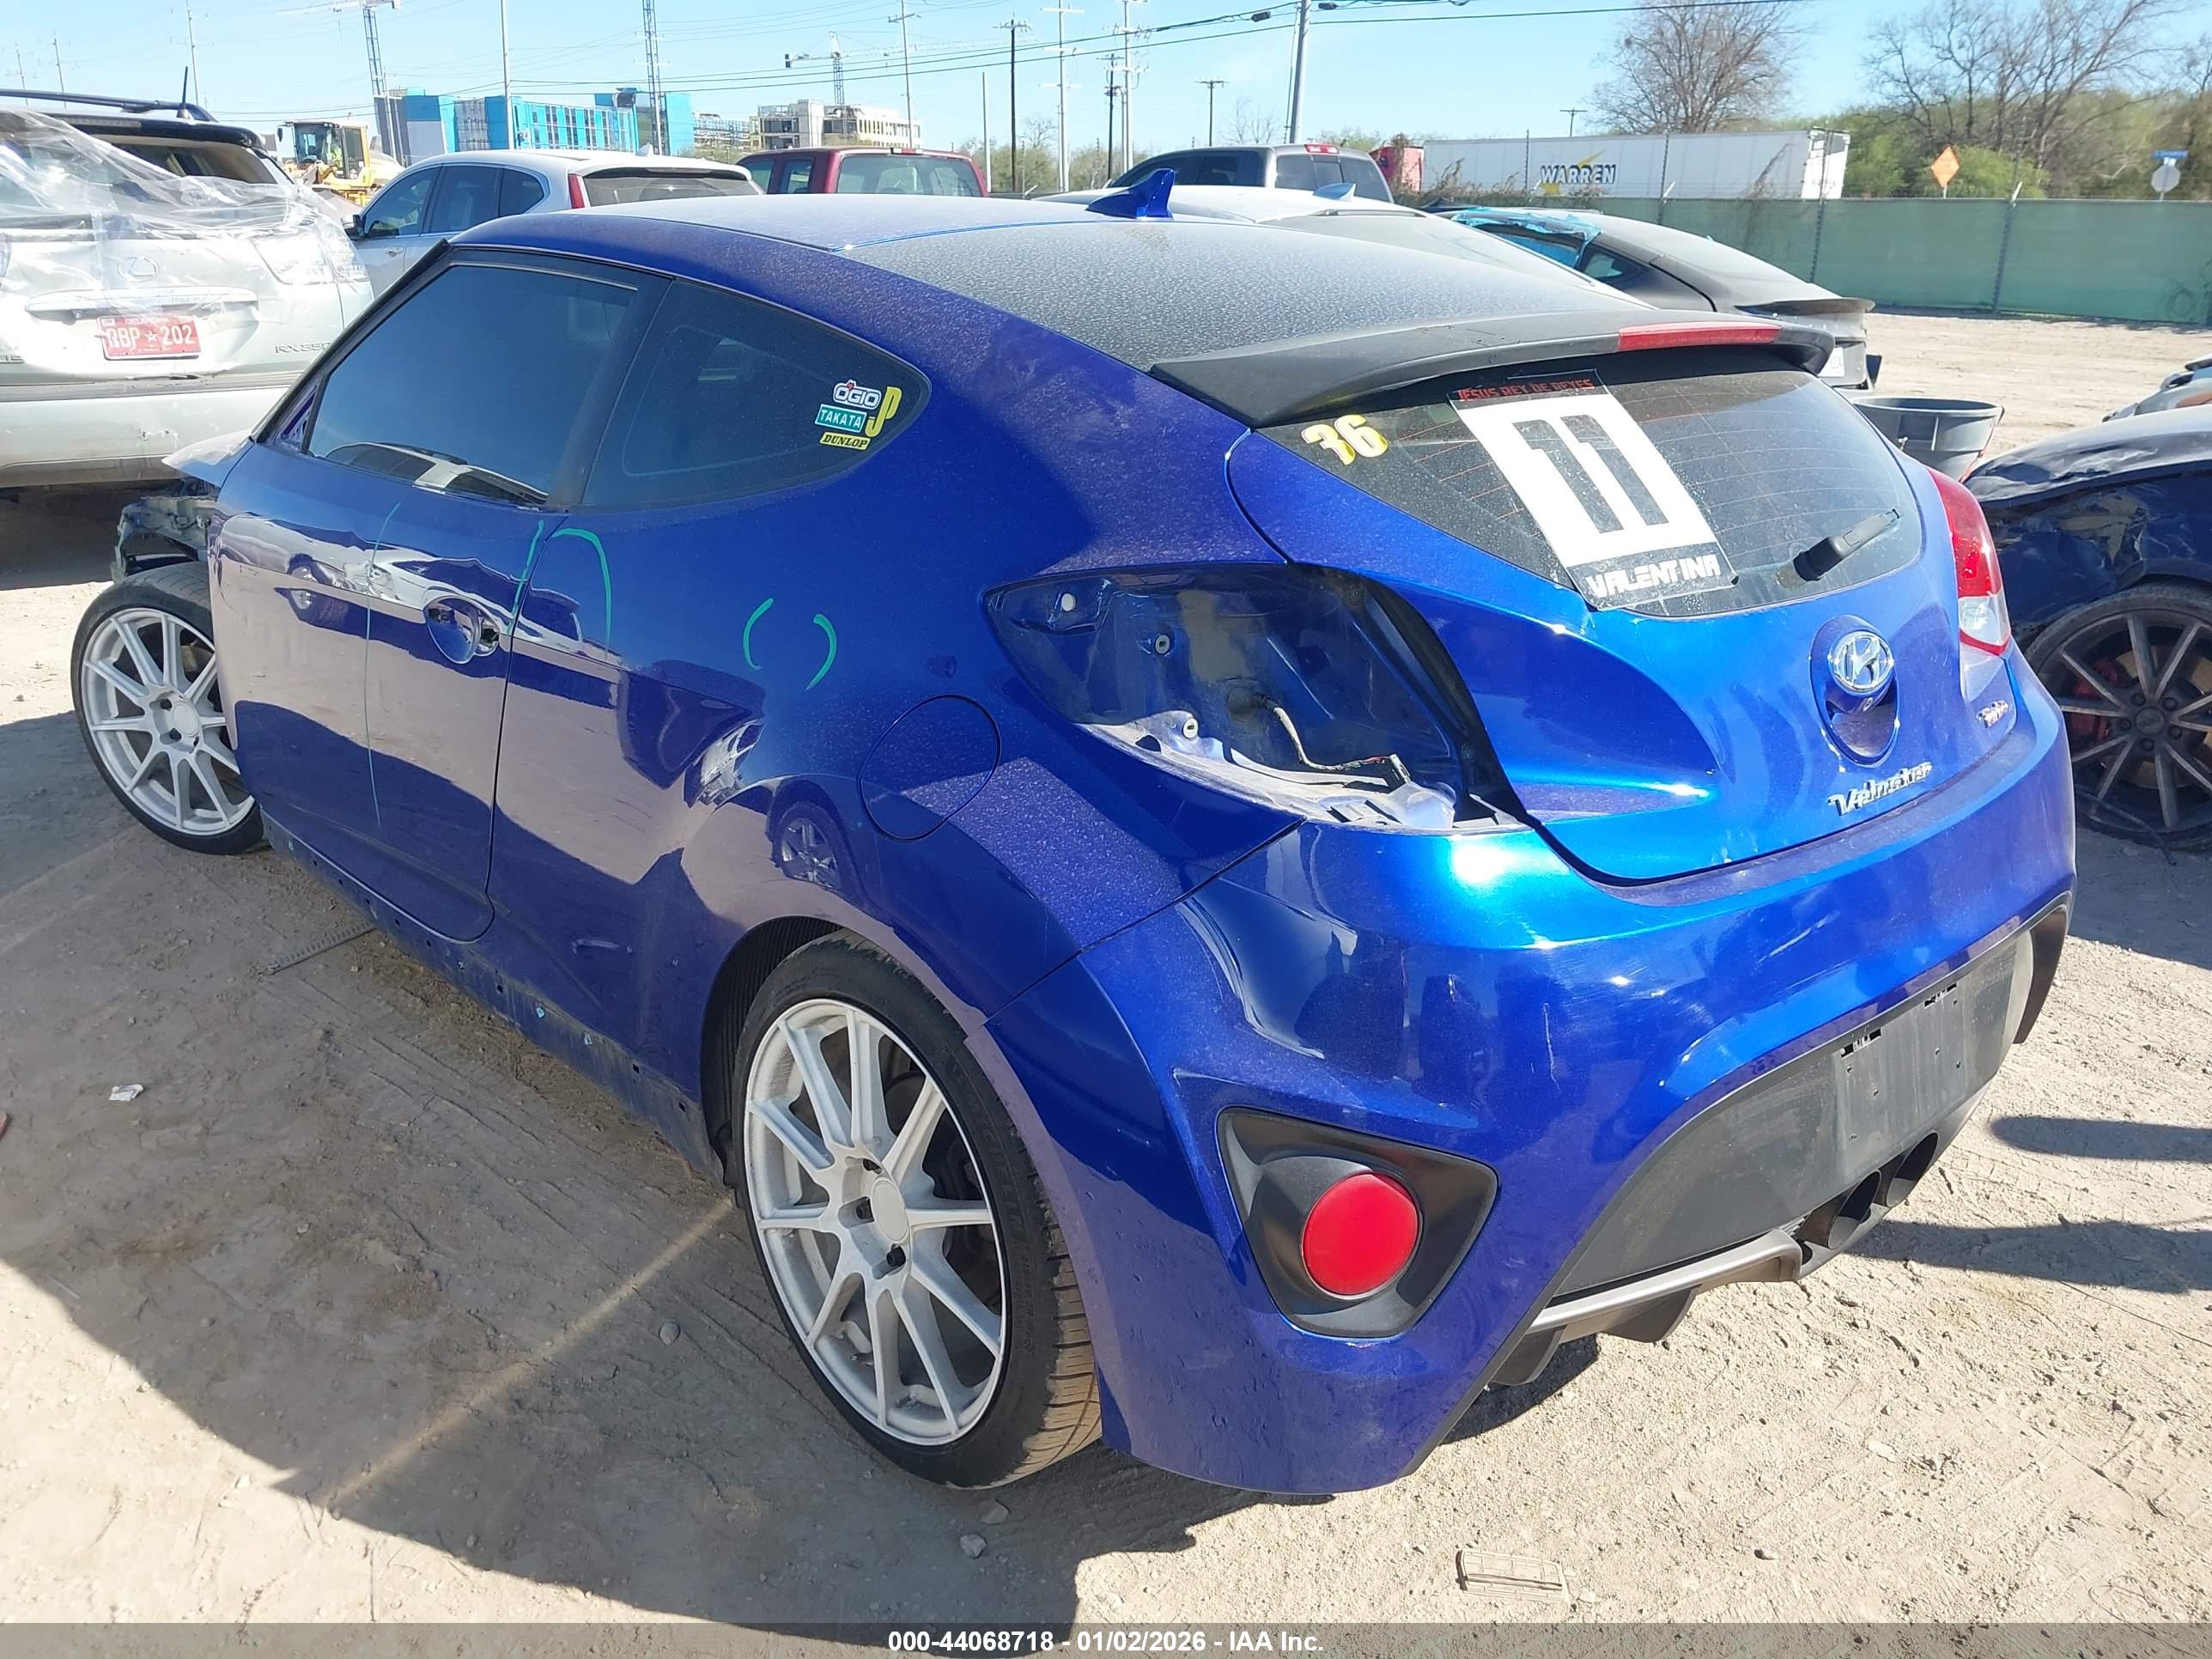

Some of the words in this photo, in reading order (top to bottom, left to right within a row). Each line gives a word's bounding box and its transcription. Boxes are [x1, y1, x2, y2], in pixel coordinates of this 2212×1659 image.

[1540, 164, 1616, 184] WARREN
[160, 325, 196, 345] 202
[1456, 388, 1499, 402] JESUS
[1499, 384, 1528, 397] REY
[1528, 382, 1551, 393] DE
[820, 408, 863, 428] TAKATA
[822, 434, 869, 449] DUNLOP
[1301, 414, 1389, 465] 36
[1511, 414, 1669, 534] 11
[1585, 554, 1722, 599] VALENTINA
